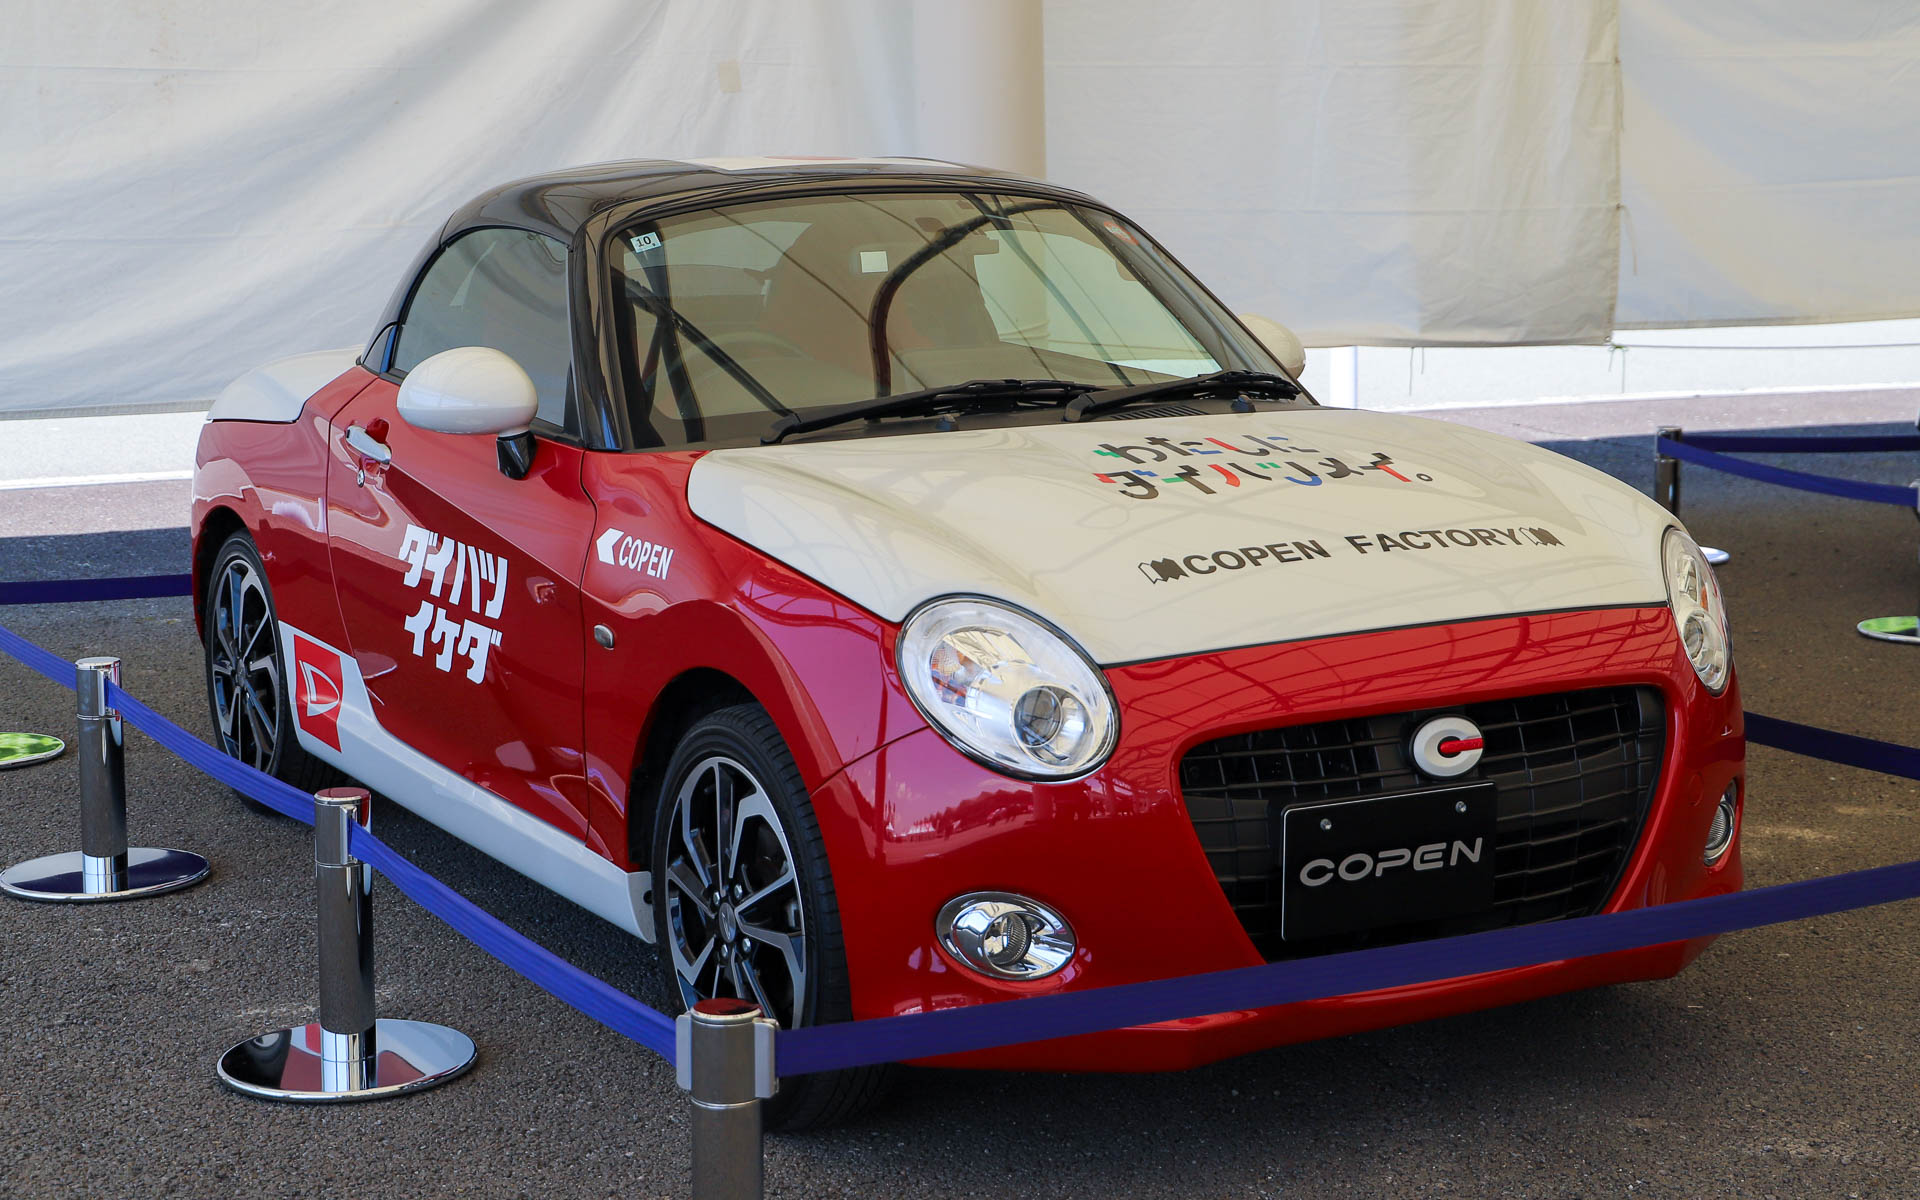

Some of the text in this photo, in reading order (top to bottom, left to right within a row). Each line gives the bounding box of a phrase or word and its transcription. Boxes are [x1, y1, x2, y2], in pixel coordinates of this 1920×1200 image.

[1093, 434, 1321, 465] わたしに
[398, 523, 508, 619] ダイハツ
[618, 534, 674, 581] COPEN
[1182, 528, 1524, 575] COPEN FACTORY
[403, 600, 503, 685] イケダ
[1299, 837, 1484, 887] COPEN
